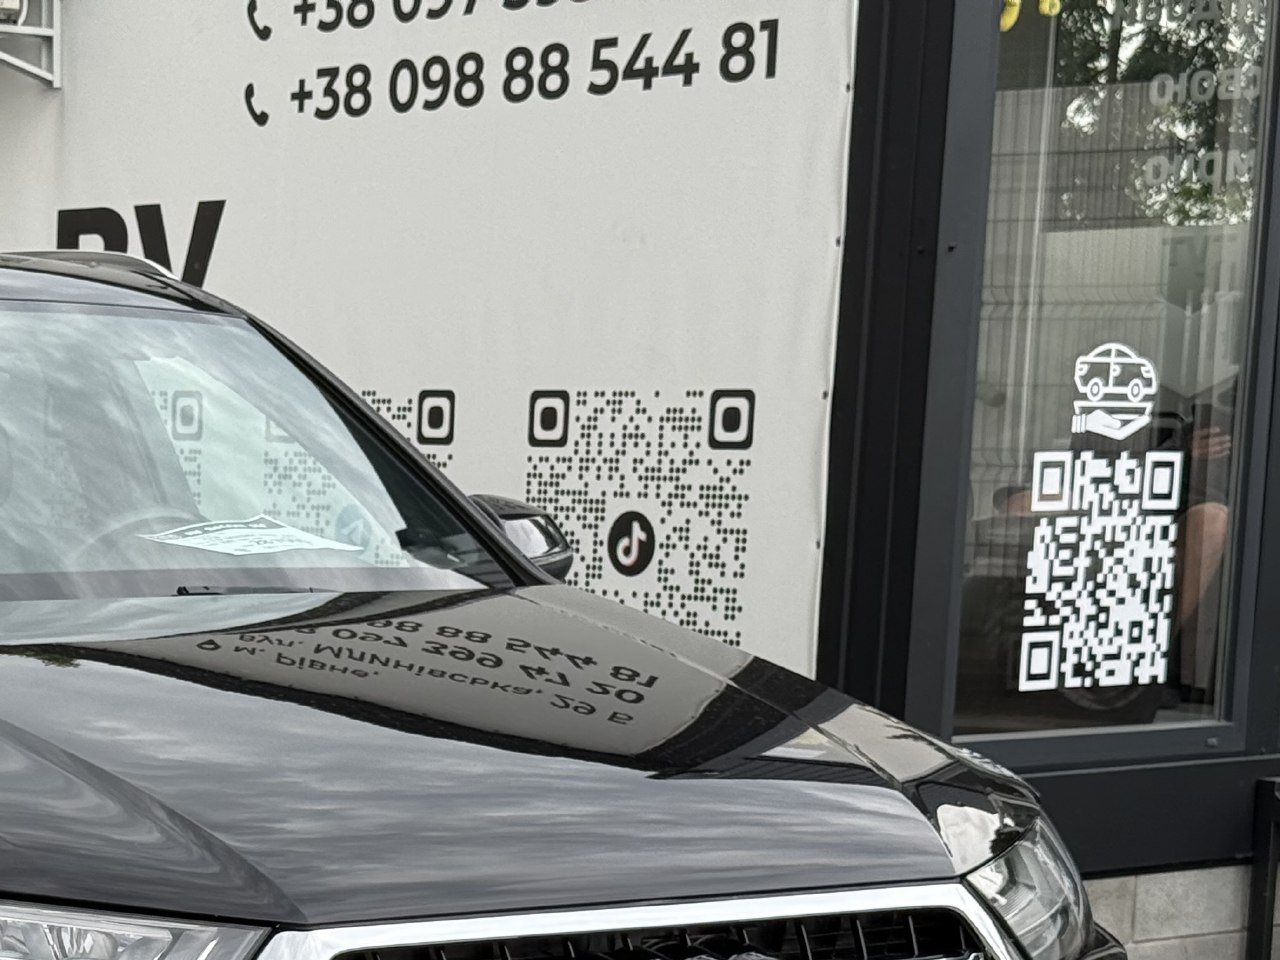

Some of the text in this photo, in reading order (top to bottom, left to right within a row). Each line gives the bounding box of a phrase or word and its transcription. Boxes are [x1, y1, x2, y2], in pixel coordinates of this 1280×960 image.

[290, 18, 780, 121] +38 098 88 544 81
